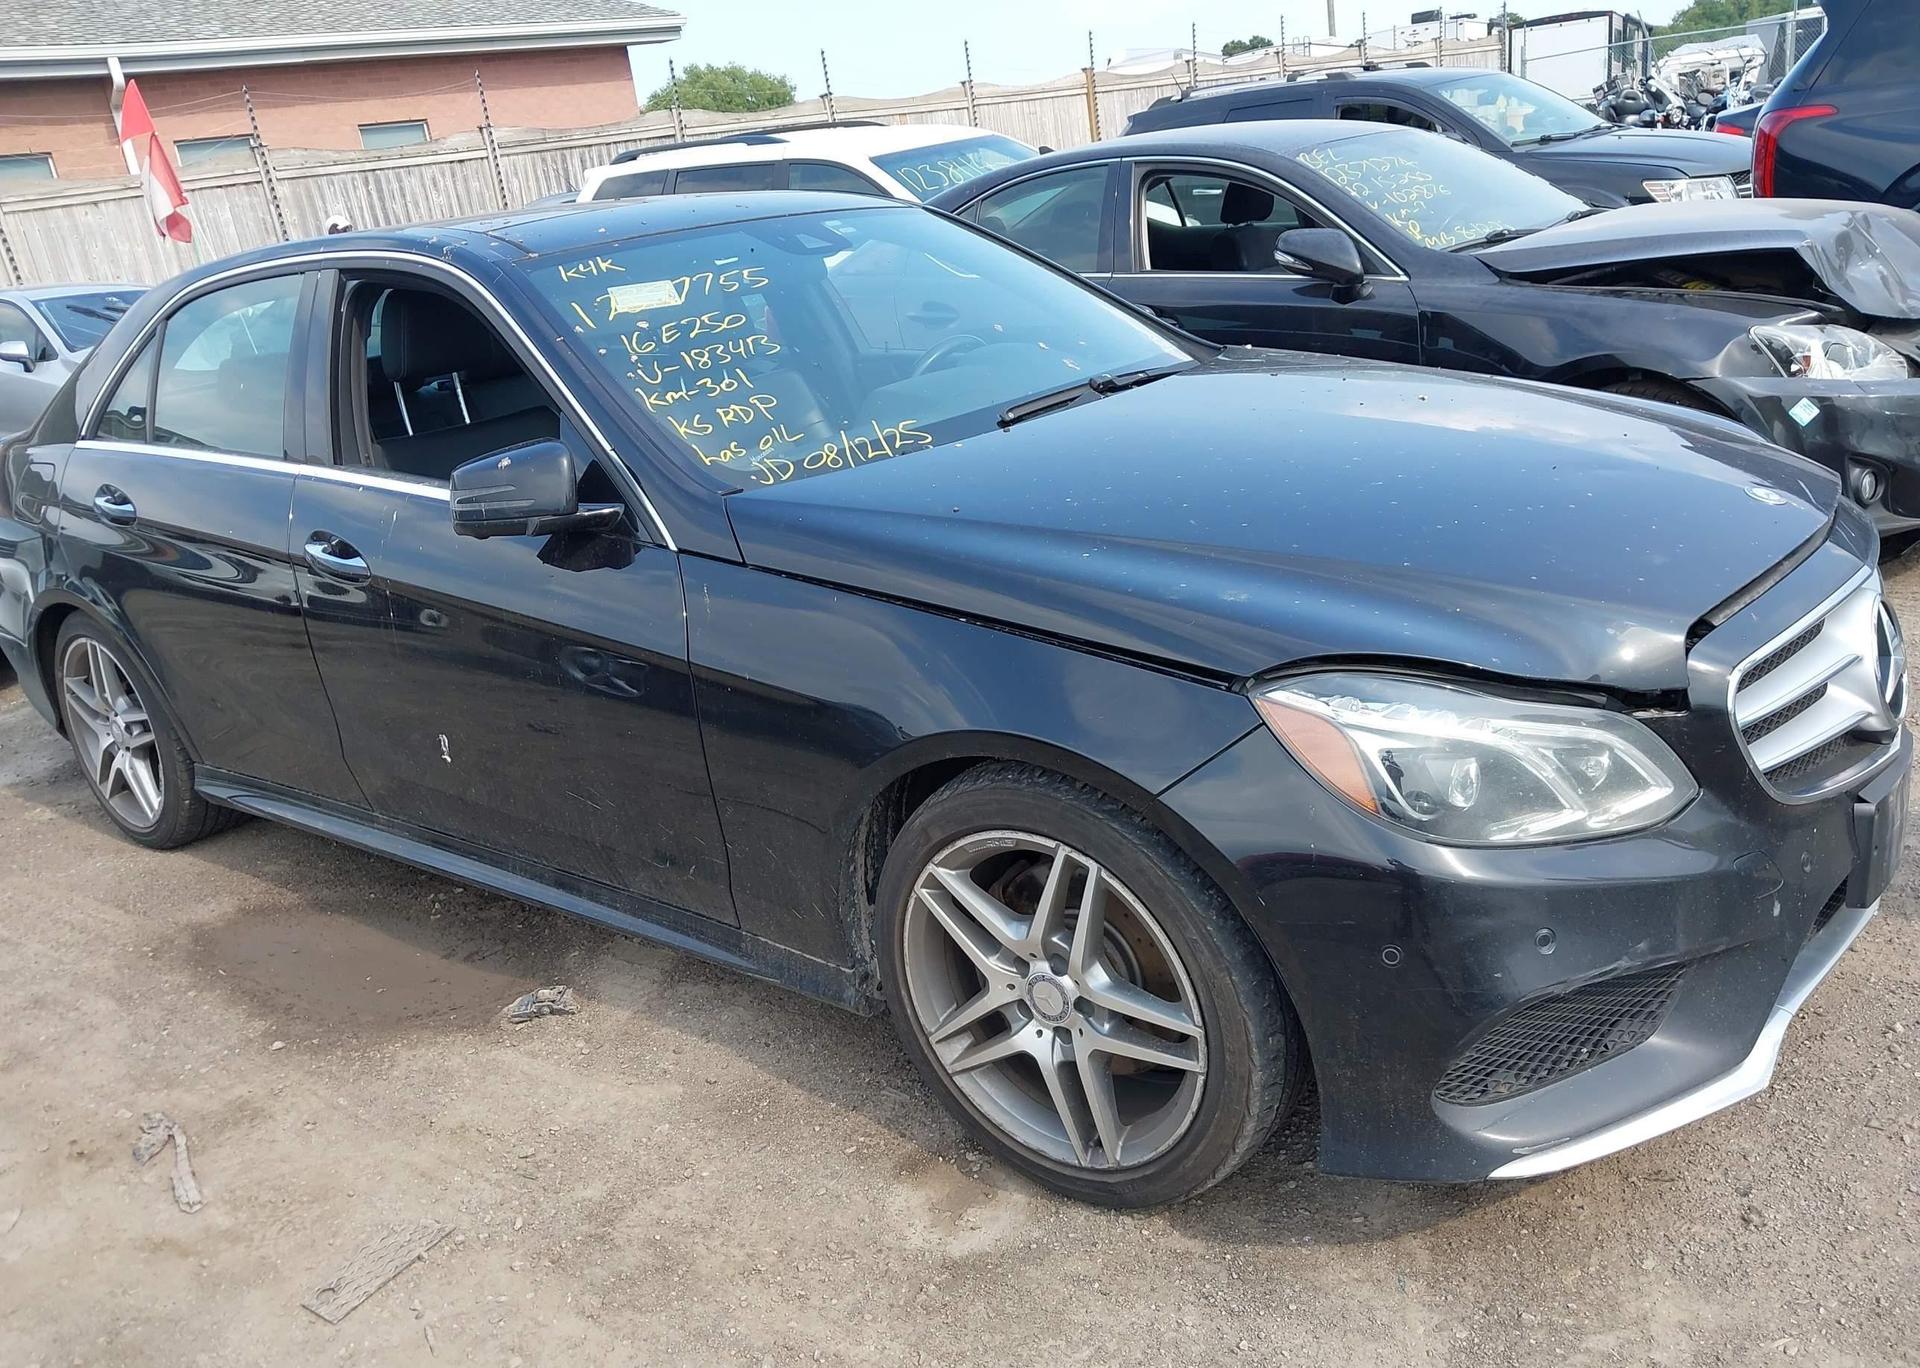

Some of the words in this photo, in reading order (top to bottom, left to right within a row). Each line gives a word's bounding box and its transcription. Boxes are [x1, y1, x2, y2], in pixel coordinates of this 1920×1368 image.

[717, 394, 777, 429] RDP
[752, 457, 795, 486] JD
[803, 419, 933, 469] 08/12/25
